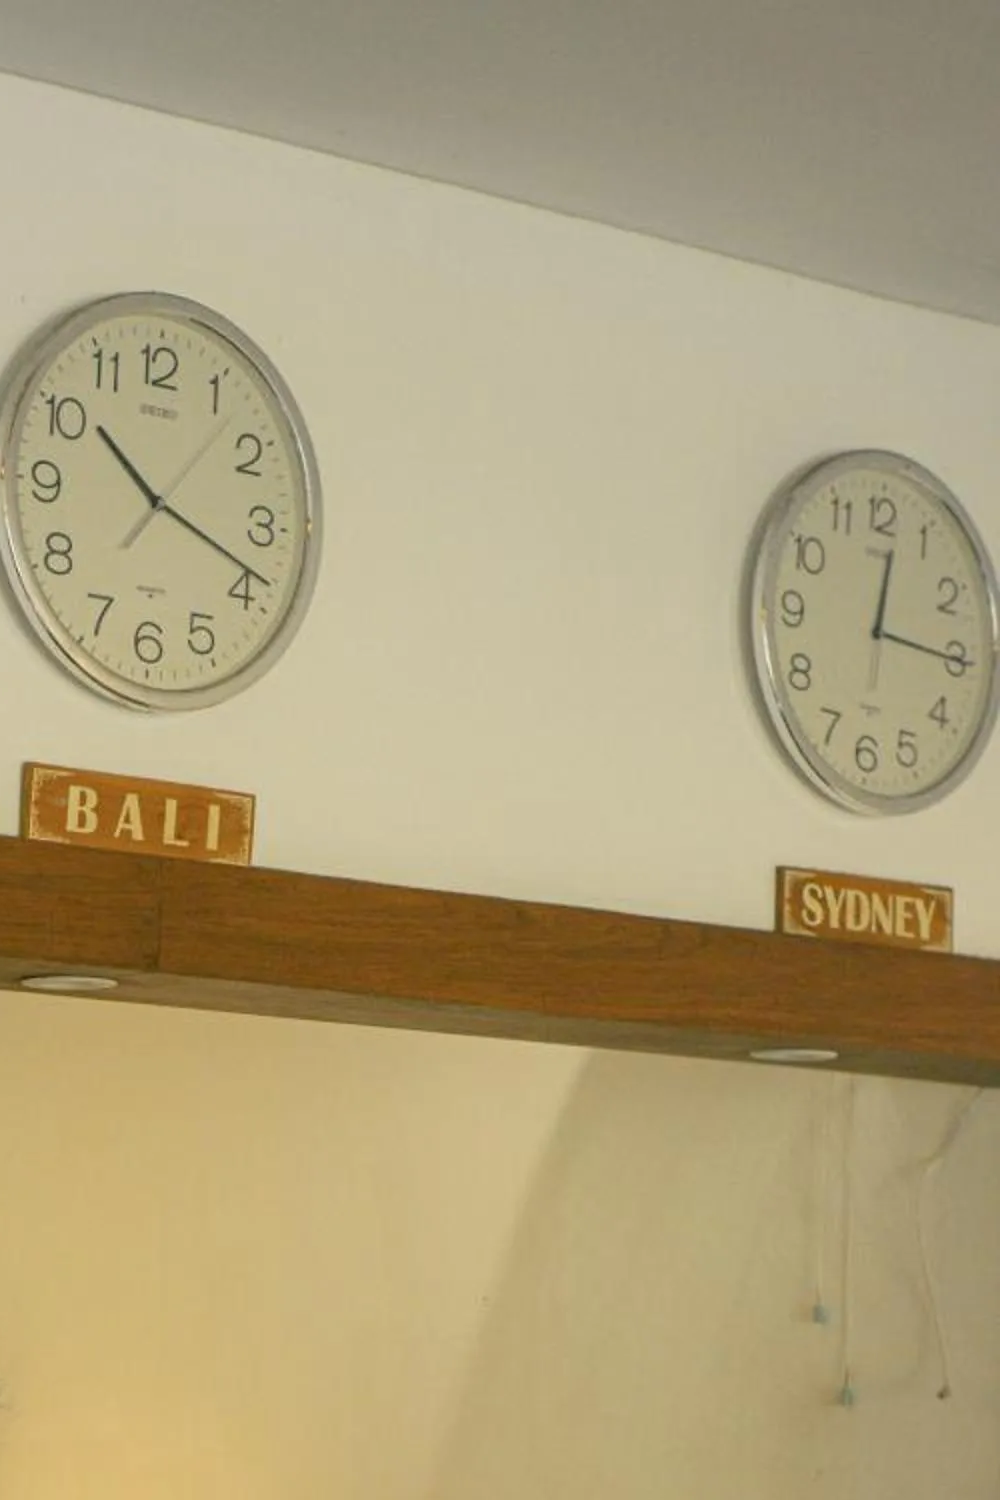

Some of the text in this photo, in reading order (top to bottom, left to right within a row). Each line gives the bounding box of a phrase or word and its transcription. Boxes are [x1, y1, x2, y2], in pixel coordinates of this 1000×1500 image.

[92, 348, 119, 393] 11
[141, 343, 179, 391] 12
[209, 374, 220, 416] 1
[45, 394, 87, 440] 10
[235, 433, 262, 477] 2
[31, 460, 61, 503] 9
[247, 505, 275, 547] 3
[831, 495, 852, 535] 11
[868, 496, 898, 537] 12
[43, 532, 73, 576] 8
[795, 534, 825, 575] 10
[919, 524, 928, 560] 1
[227, 569, 255, 610] 4
[781, 589, 805, 628] 9
[936, 576, 960, 616] 2
[87, 593, 115, 637] 7
[187, 612, 215, 655] 5
[133, 621, 163, 665] 6
[788, 653, 812, 691] 8
[820, 707, 842, 745] 7
[927, 696, 950, 729] 4
[855, 735, 878, 773] 6
[895, 730, 918, 769] 5
[65, 785, 220, 851] BALI
[802, 882, 937, 941] SYDNEY
